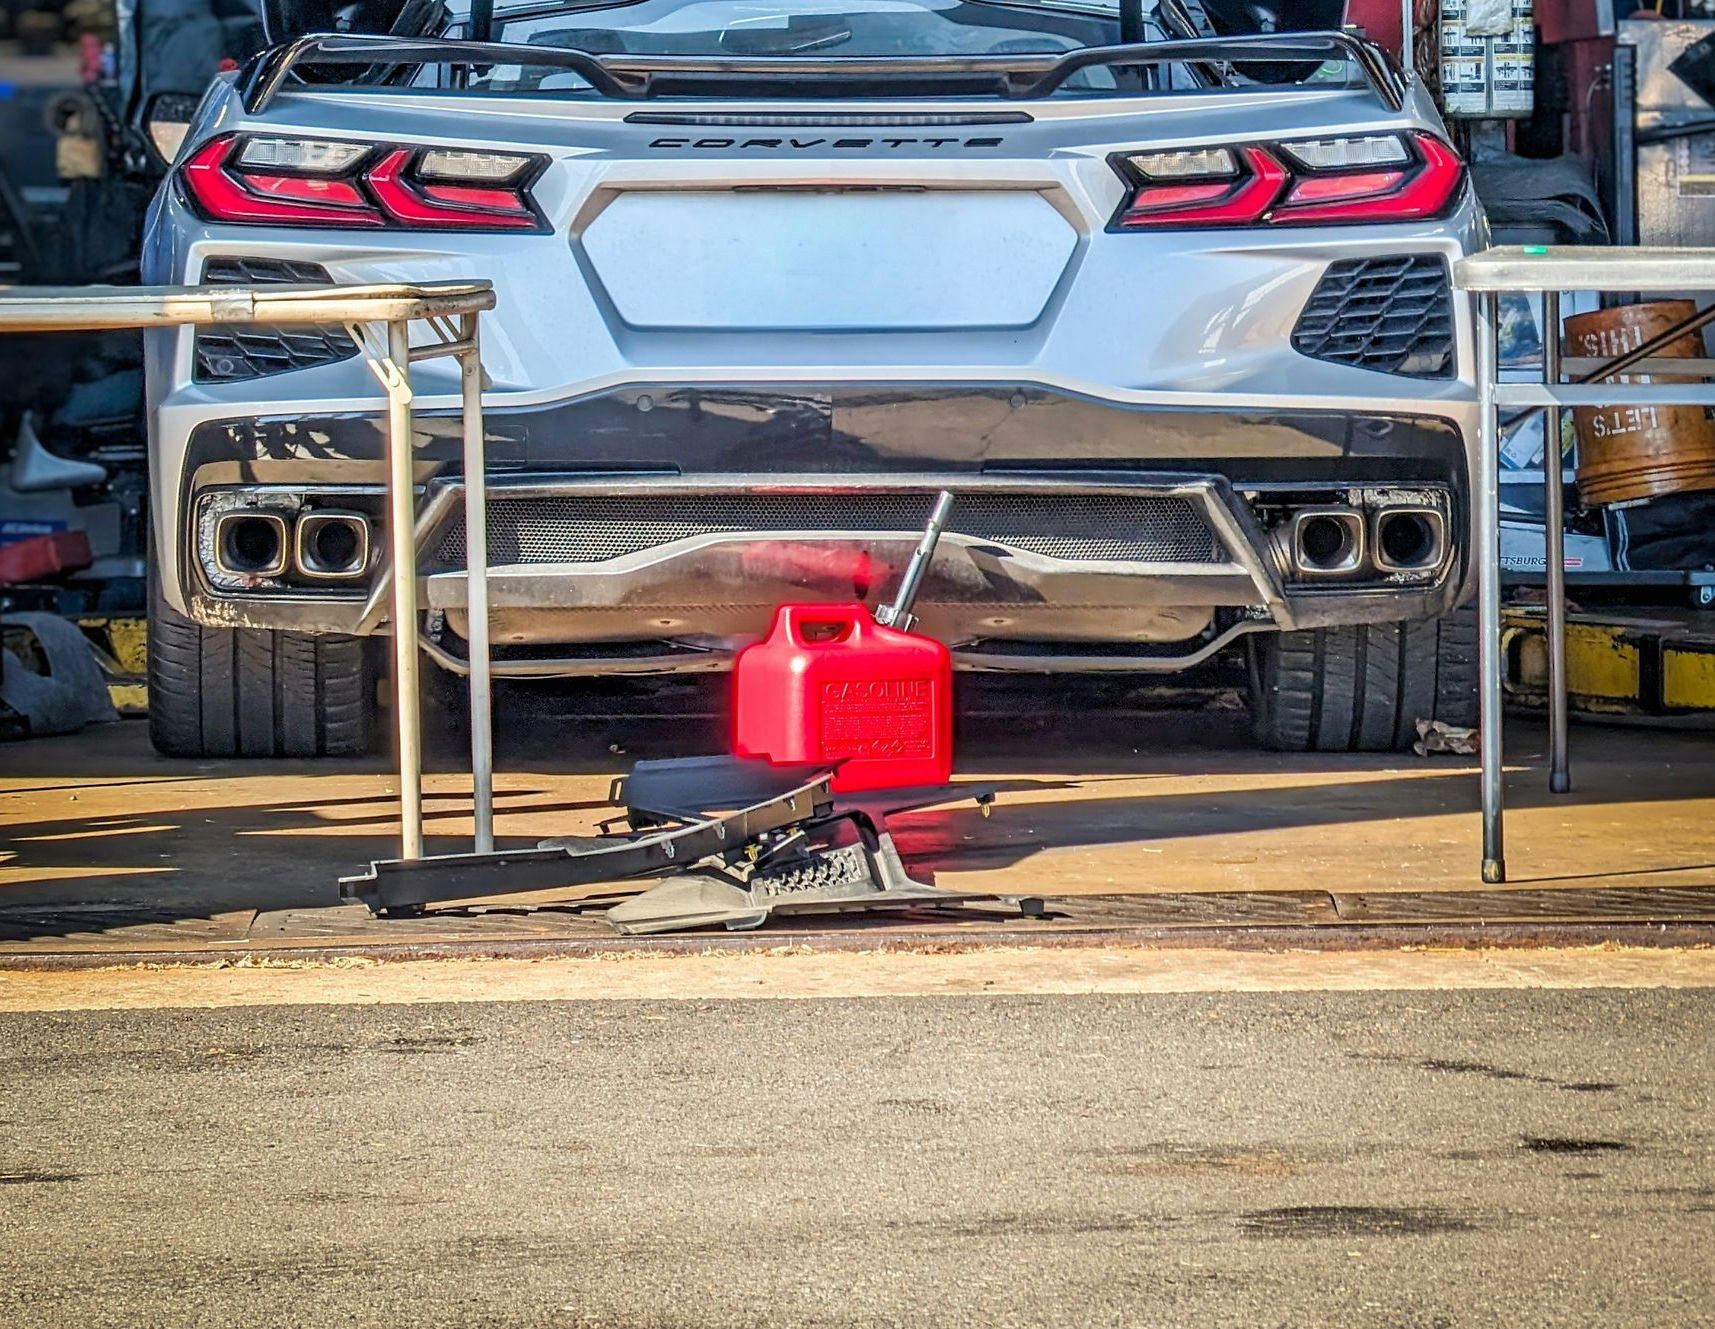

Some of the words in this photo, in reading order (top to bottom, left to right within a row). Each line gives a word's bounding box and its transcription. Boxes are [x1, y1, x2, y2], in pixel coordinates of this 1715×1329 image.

[648, 137, 1004, 149] CORVETTE
[1592, 407, 1658, 438] LET'S
[1499, 556, 1547, 566] TSBURG
[824, 679, 928, 699] GASOLINE
